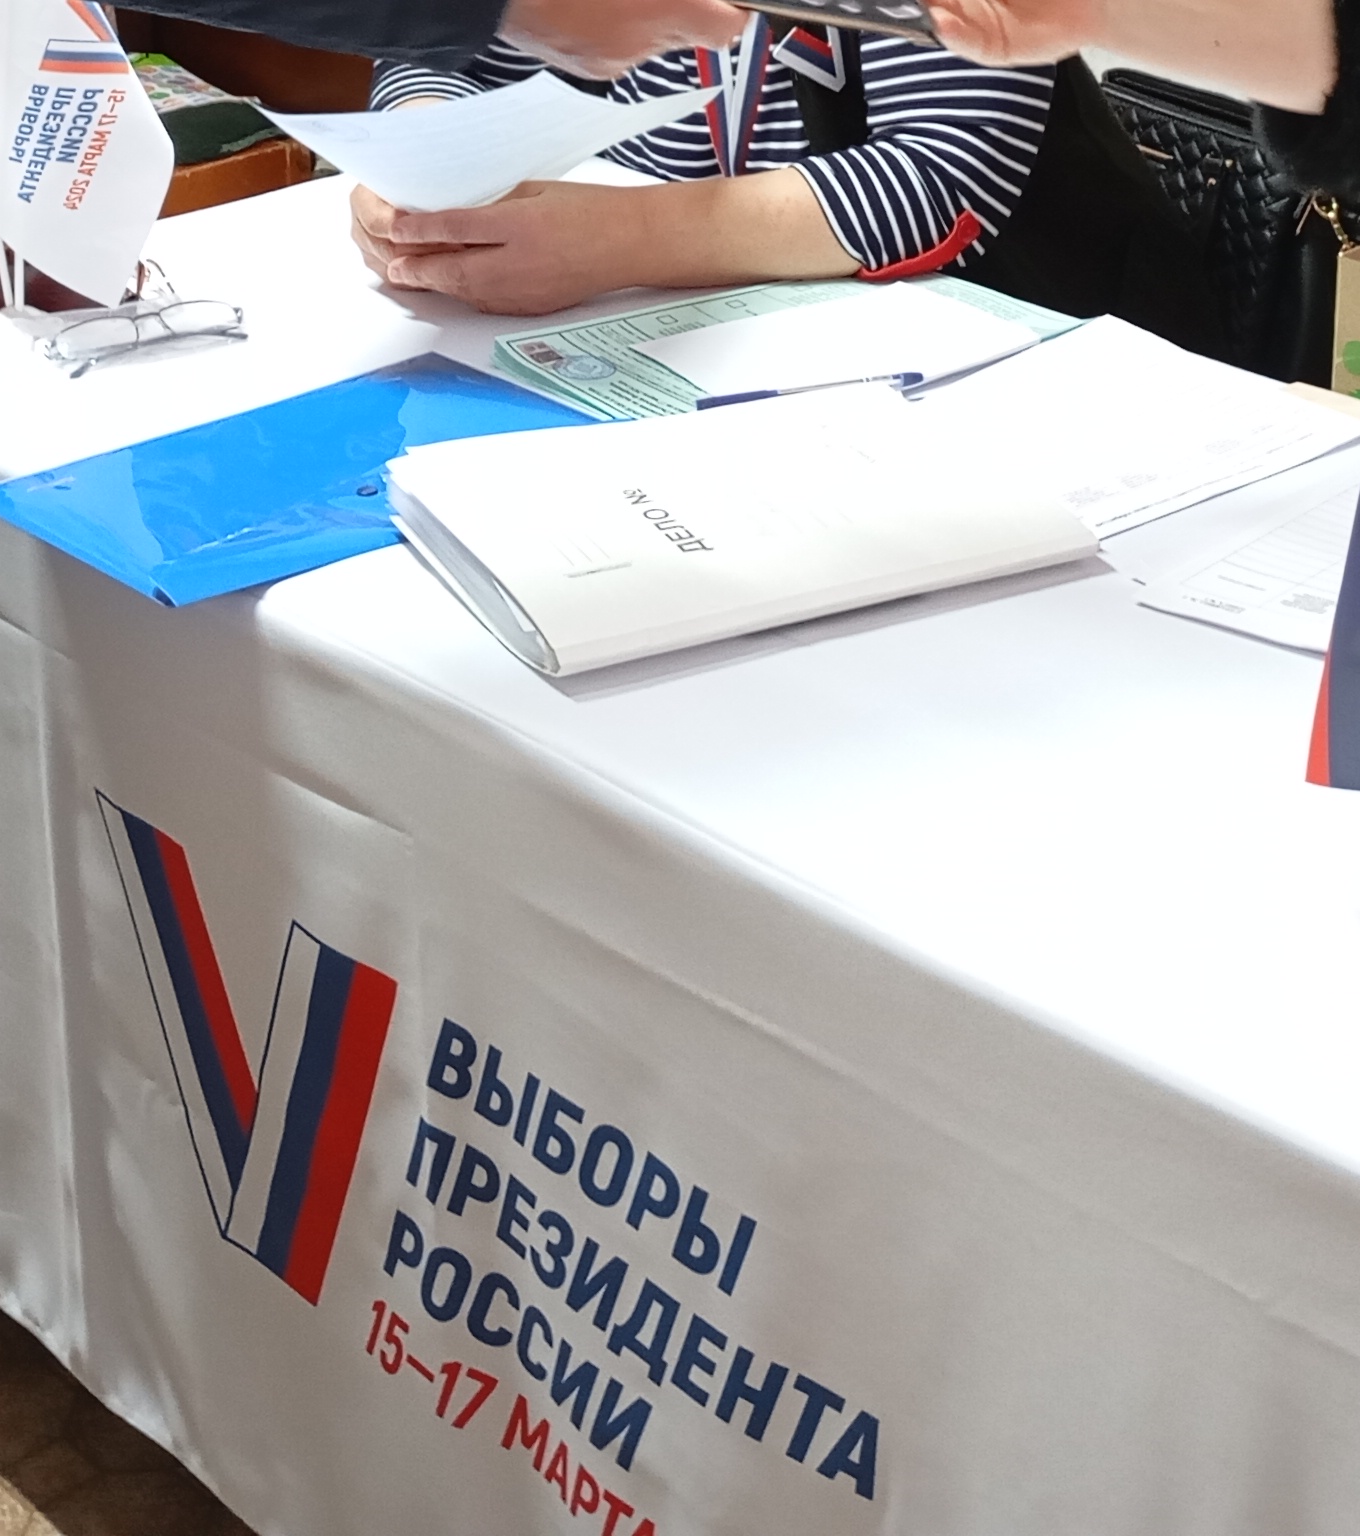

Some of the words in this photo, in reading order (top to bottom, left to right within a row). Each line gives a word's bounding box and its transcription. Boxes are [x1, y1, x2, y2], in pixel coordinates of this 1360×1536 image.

[623, 488, 653, 505] №
[643, 508, 714, 553] ДЕЛО
[426, 1017, 757, 1296] ВЫБОРЫ
[383, 1209, 653, 1472] РОССИИ
[404, 1116, 880, 1501] ПРЕЗИДЕНТА
